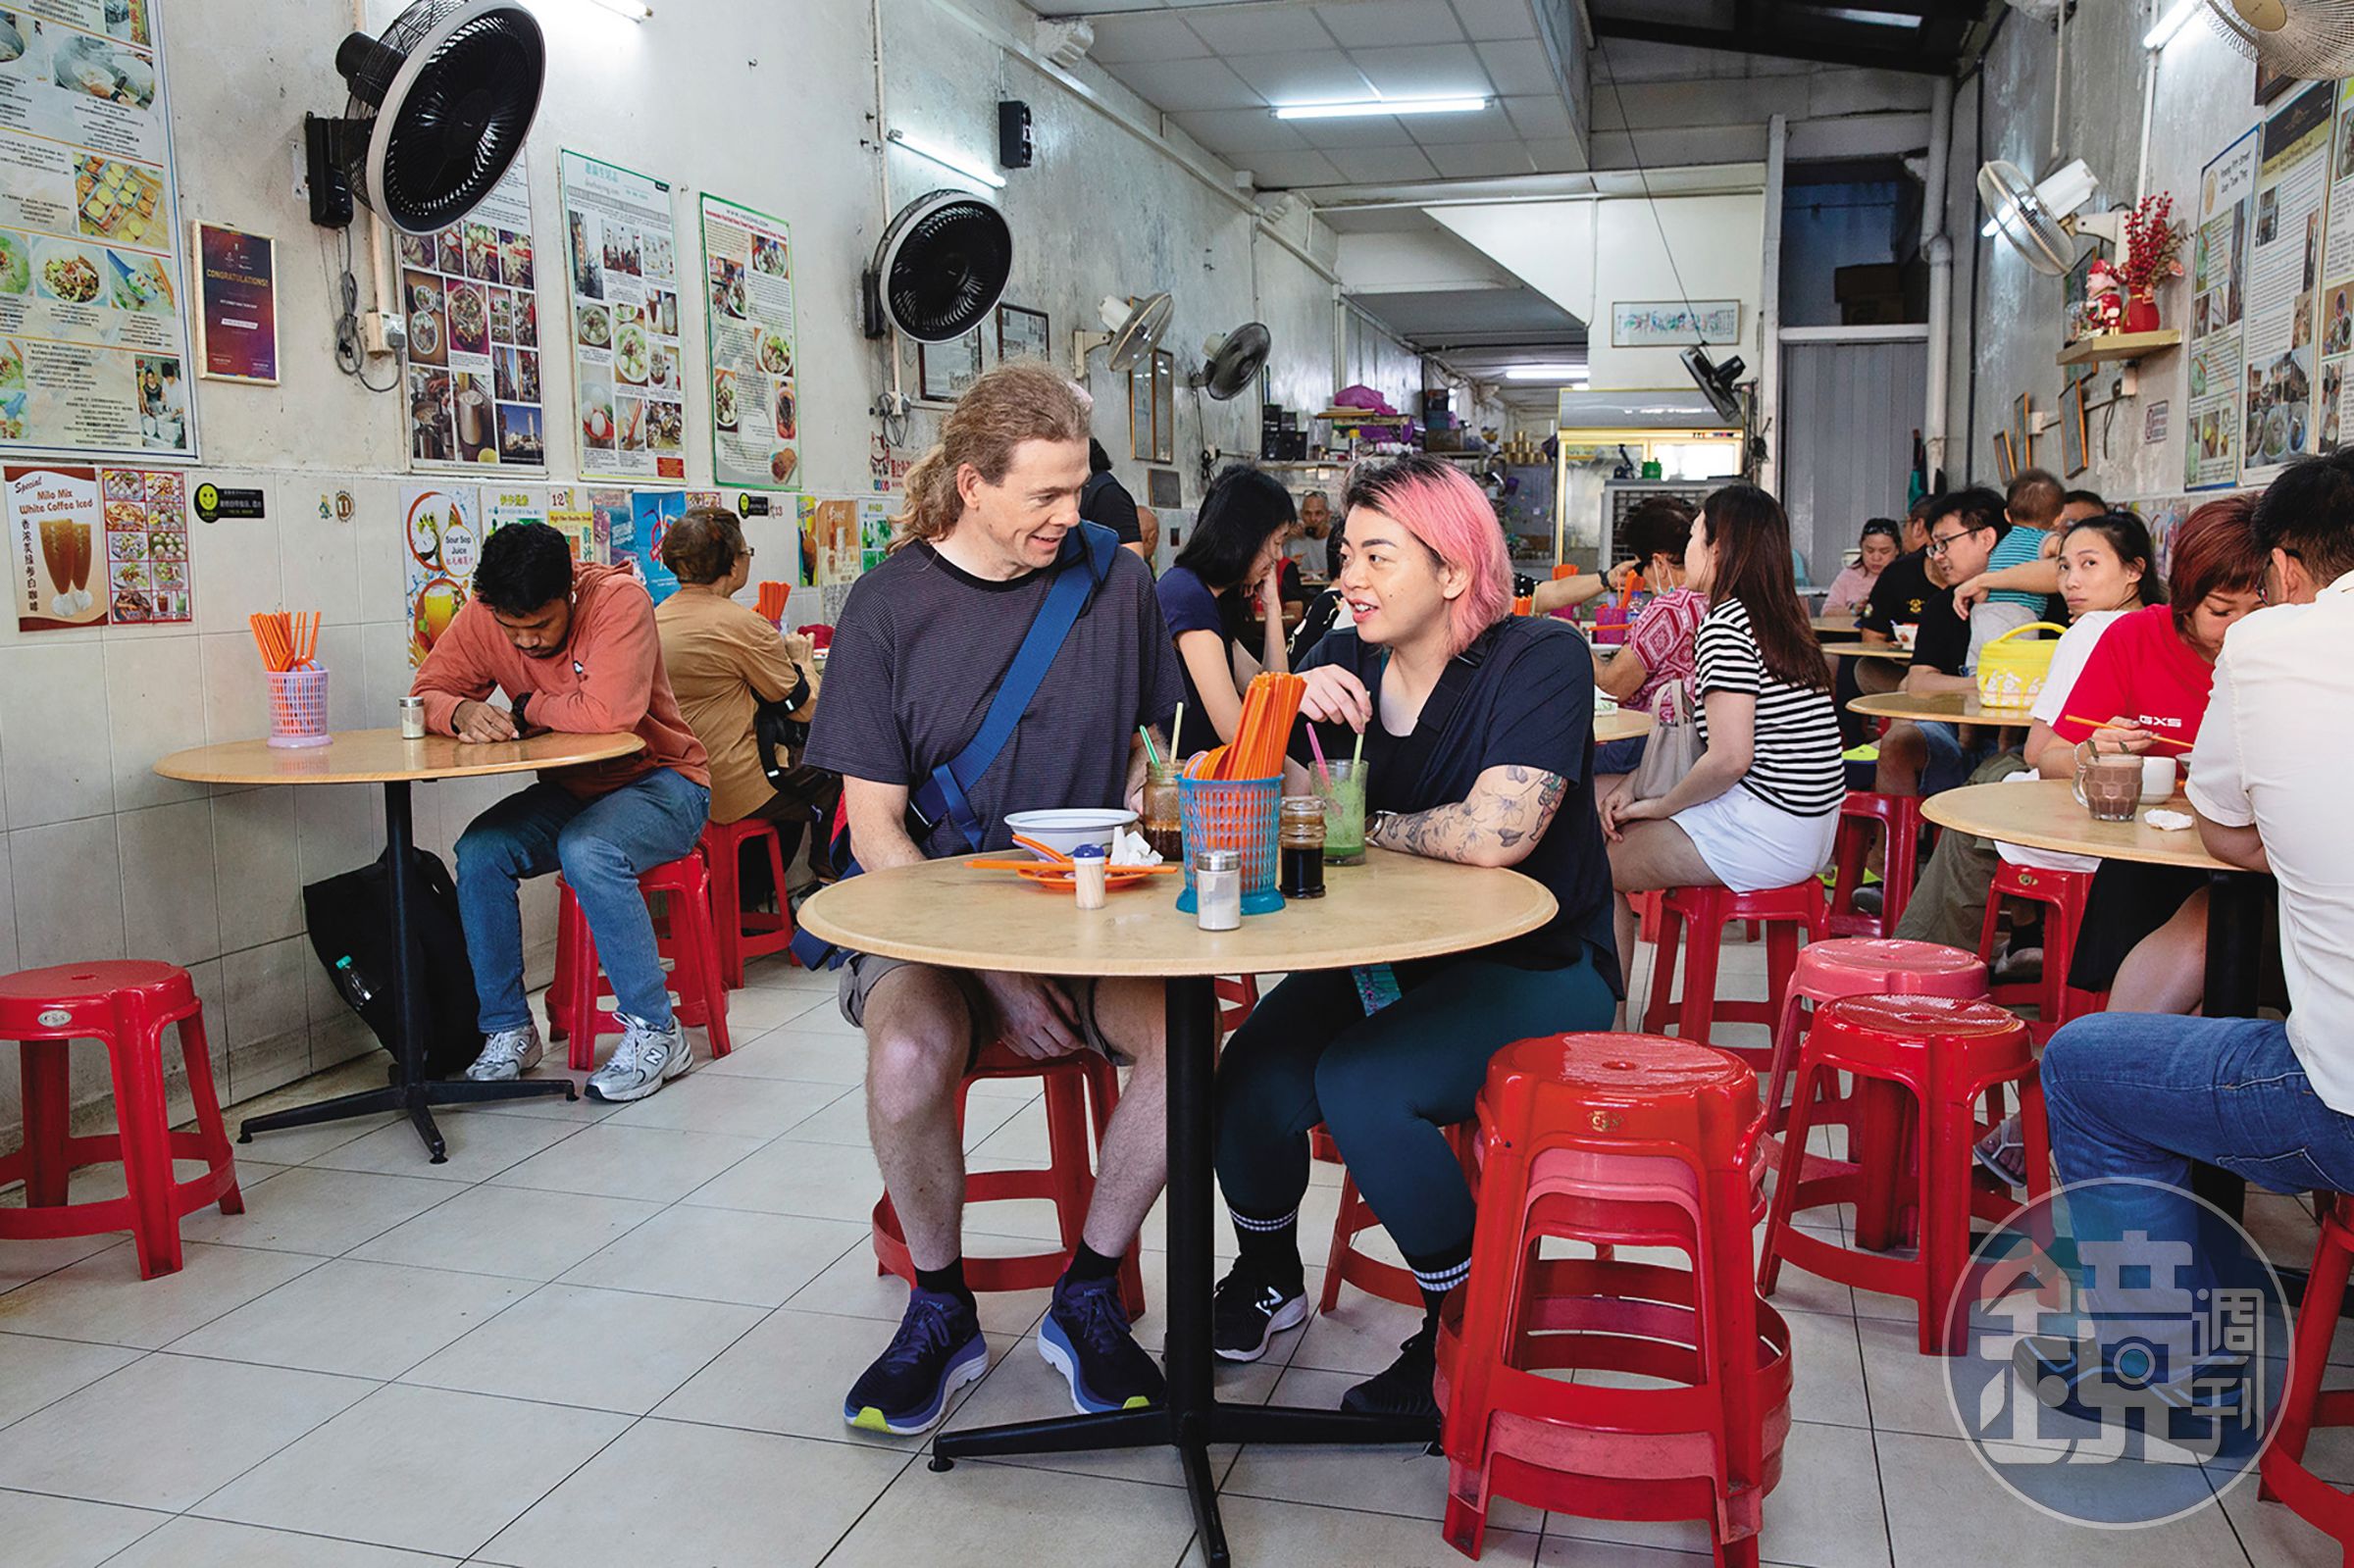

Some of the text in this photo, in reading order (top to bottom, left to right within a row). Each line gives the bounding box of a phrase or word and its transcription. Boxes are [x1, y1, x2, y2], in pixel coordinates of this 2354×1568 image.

[15, 476, 42, 494] Special
[37, 488, 73, 501] Milo Mix
[552, 492, 565, 507] 12
[20, 498, 93, 515] White Coffee Iced
[445, 535, 472, 544] Sour Sop
[2139, 715, 2182, 728] GXS
